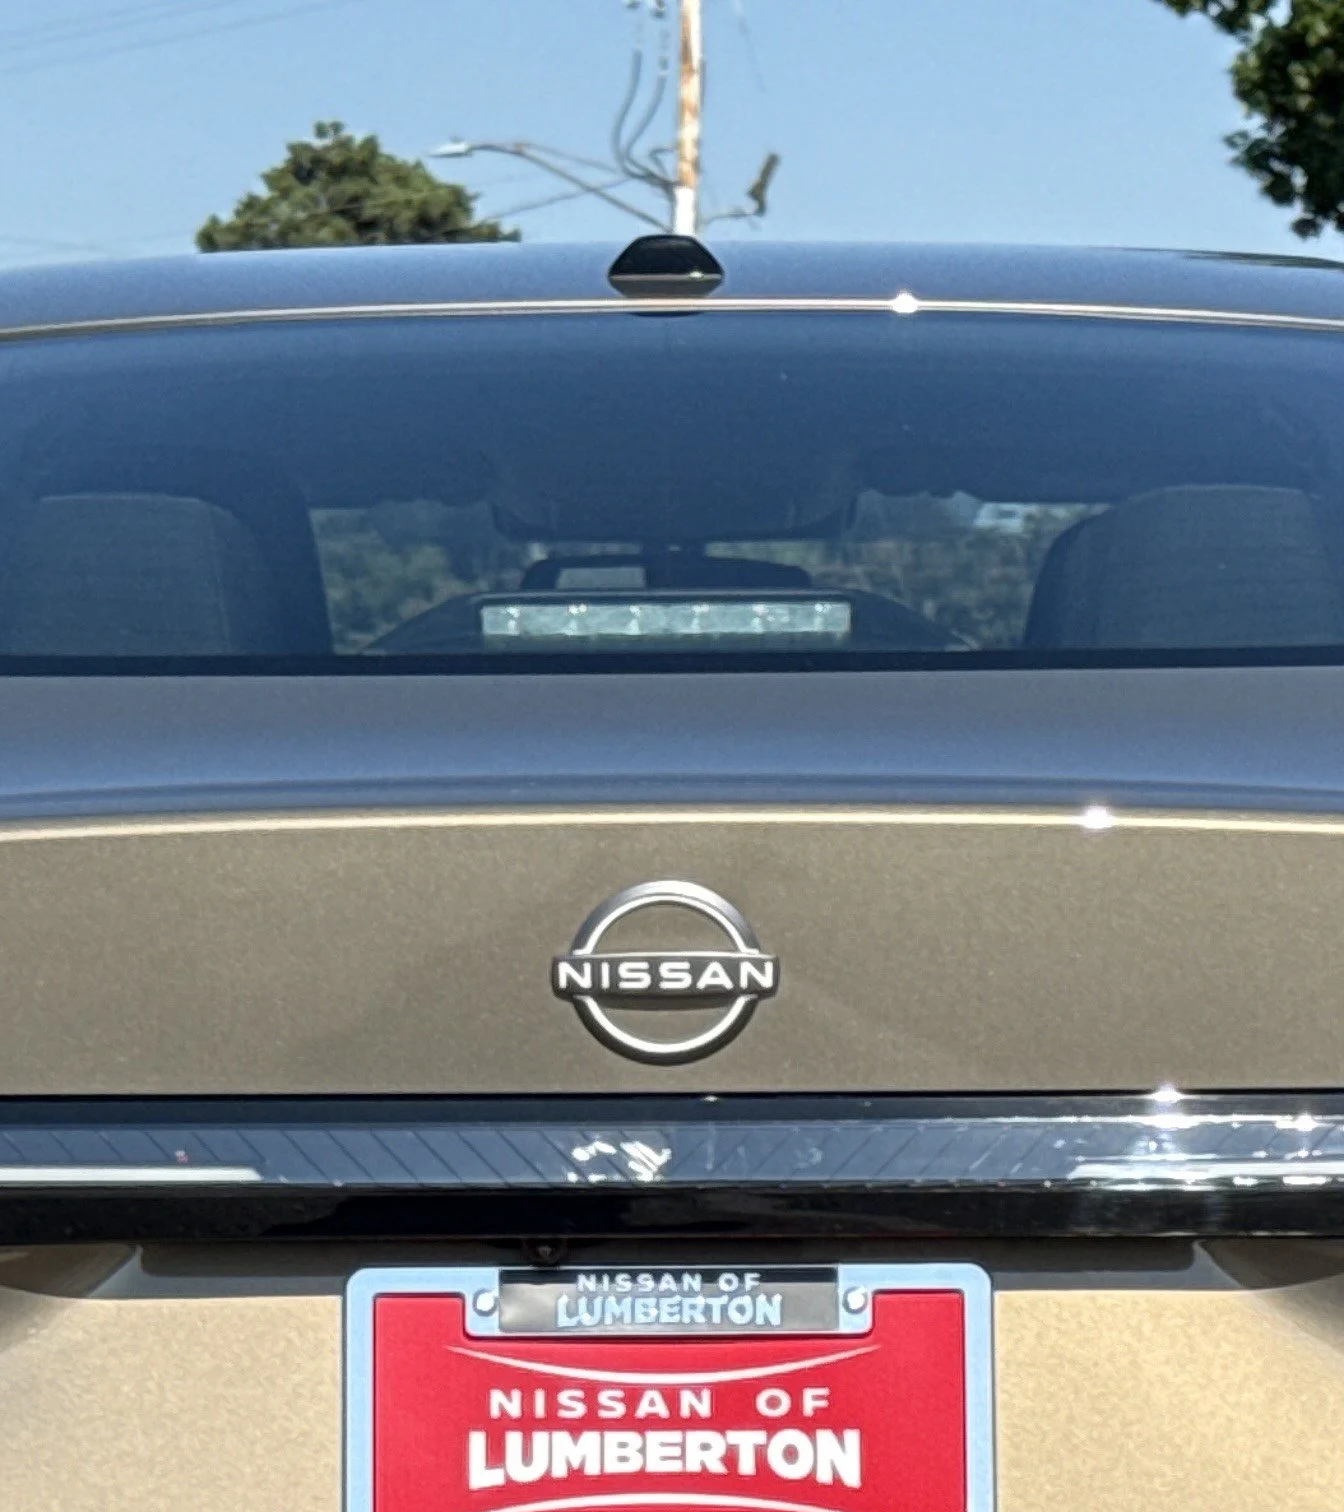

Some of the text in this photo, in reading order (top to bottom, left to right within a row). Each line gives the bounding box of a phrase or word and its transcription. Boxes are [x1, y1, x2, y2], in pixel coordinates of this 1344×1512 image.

[557, 960, 775, 990] NISSAN
[576, 1271, 762, 1293] NISSAN OF
[556, 1294, 783, 1327] LUMBERTON
[489, 1387, 830, 1419] NISSAN OF
[468, 1428, 862, 1490] LUMBERTON
